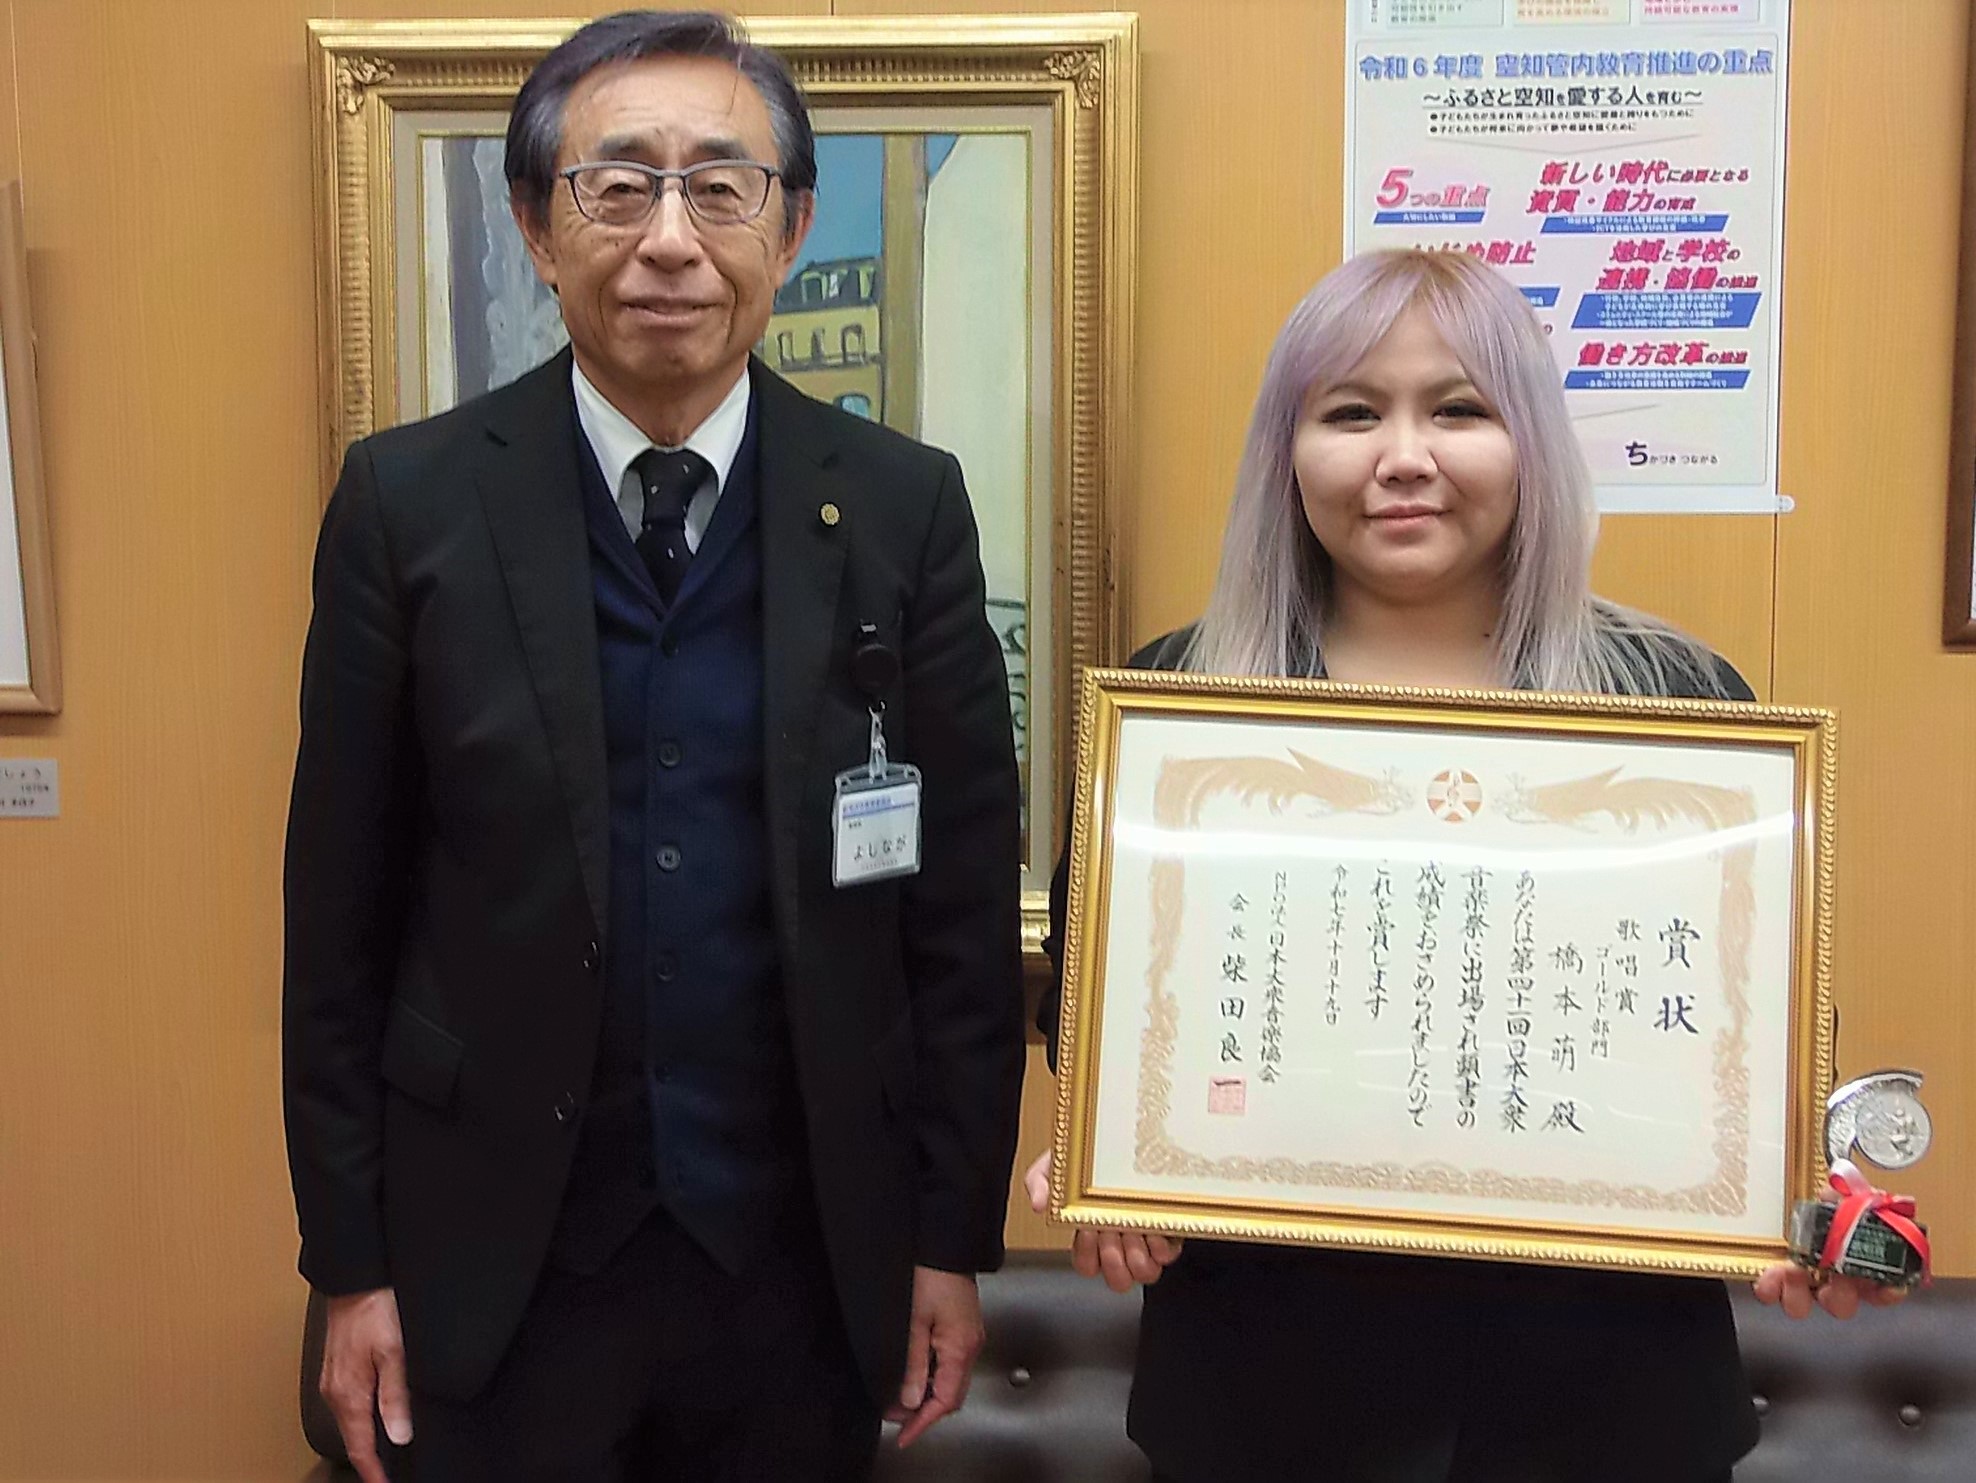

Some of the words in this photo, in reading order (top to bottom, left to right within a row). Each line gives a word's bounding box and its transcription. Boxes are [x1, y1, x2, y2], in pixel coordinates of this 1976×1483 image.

[1495, 49, 1775, 77] 空知管内教育推進の重点
[1615, 918, 1643, 1015] 歌唱賞
[1653, 917, 1702, 1035] 賞状
